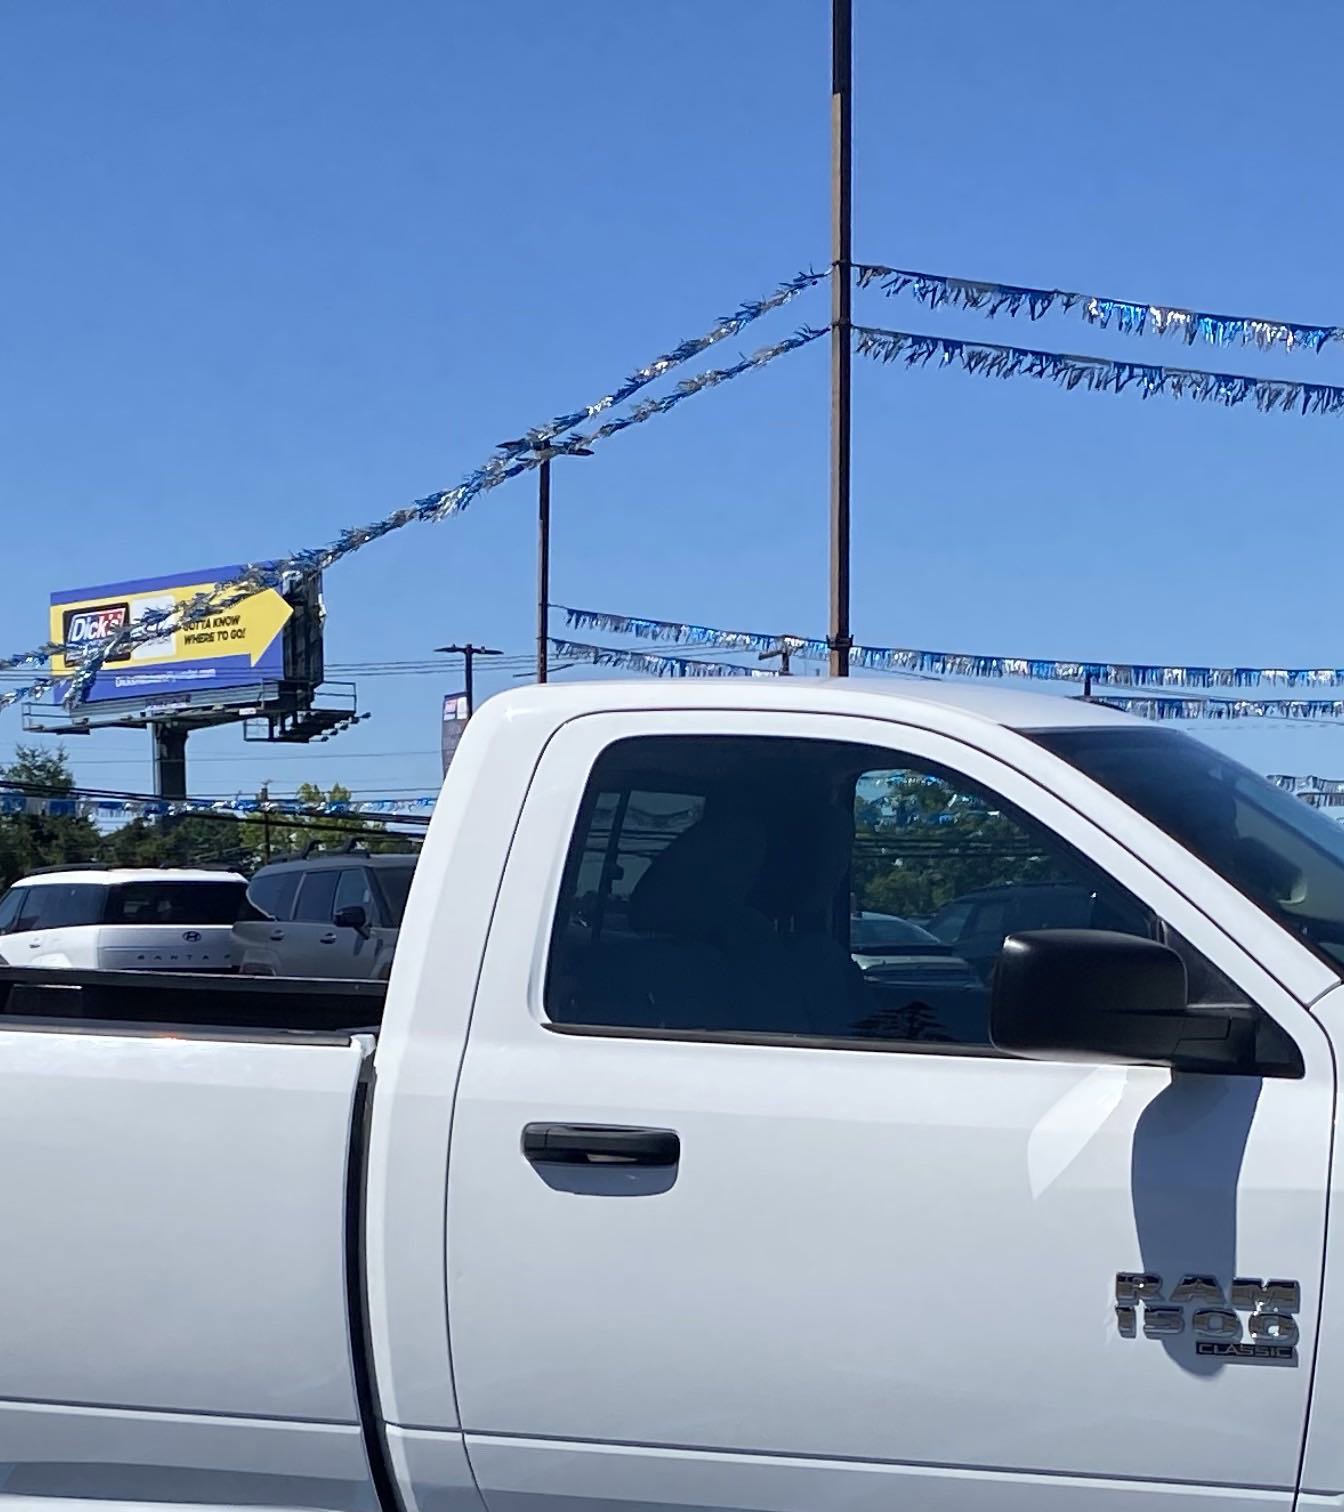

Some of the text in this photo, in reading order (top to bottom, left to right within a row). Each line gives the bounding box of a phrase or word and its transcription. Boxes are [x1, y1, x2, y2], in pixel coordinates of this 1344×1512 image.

[213, 615, 240, 628] KNOW
[184, 627, 246, 645] WHERE TO GO!
[1116, 1272, 1300, 1312] RAM
[1115, 1305, 1299, 1346] 1500
[1197, 1342, 1293, 1358] CLASSIC
